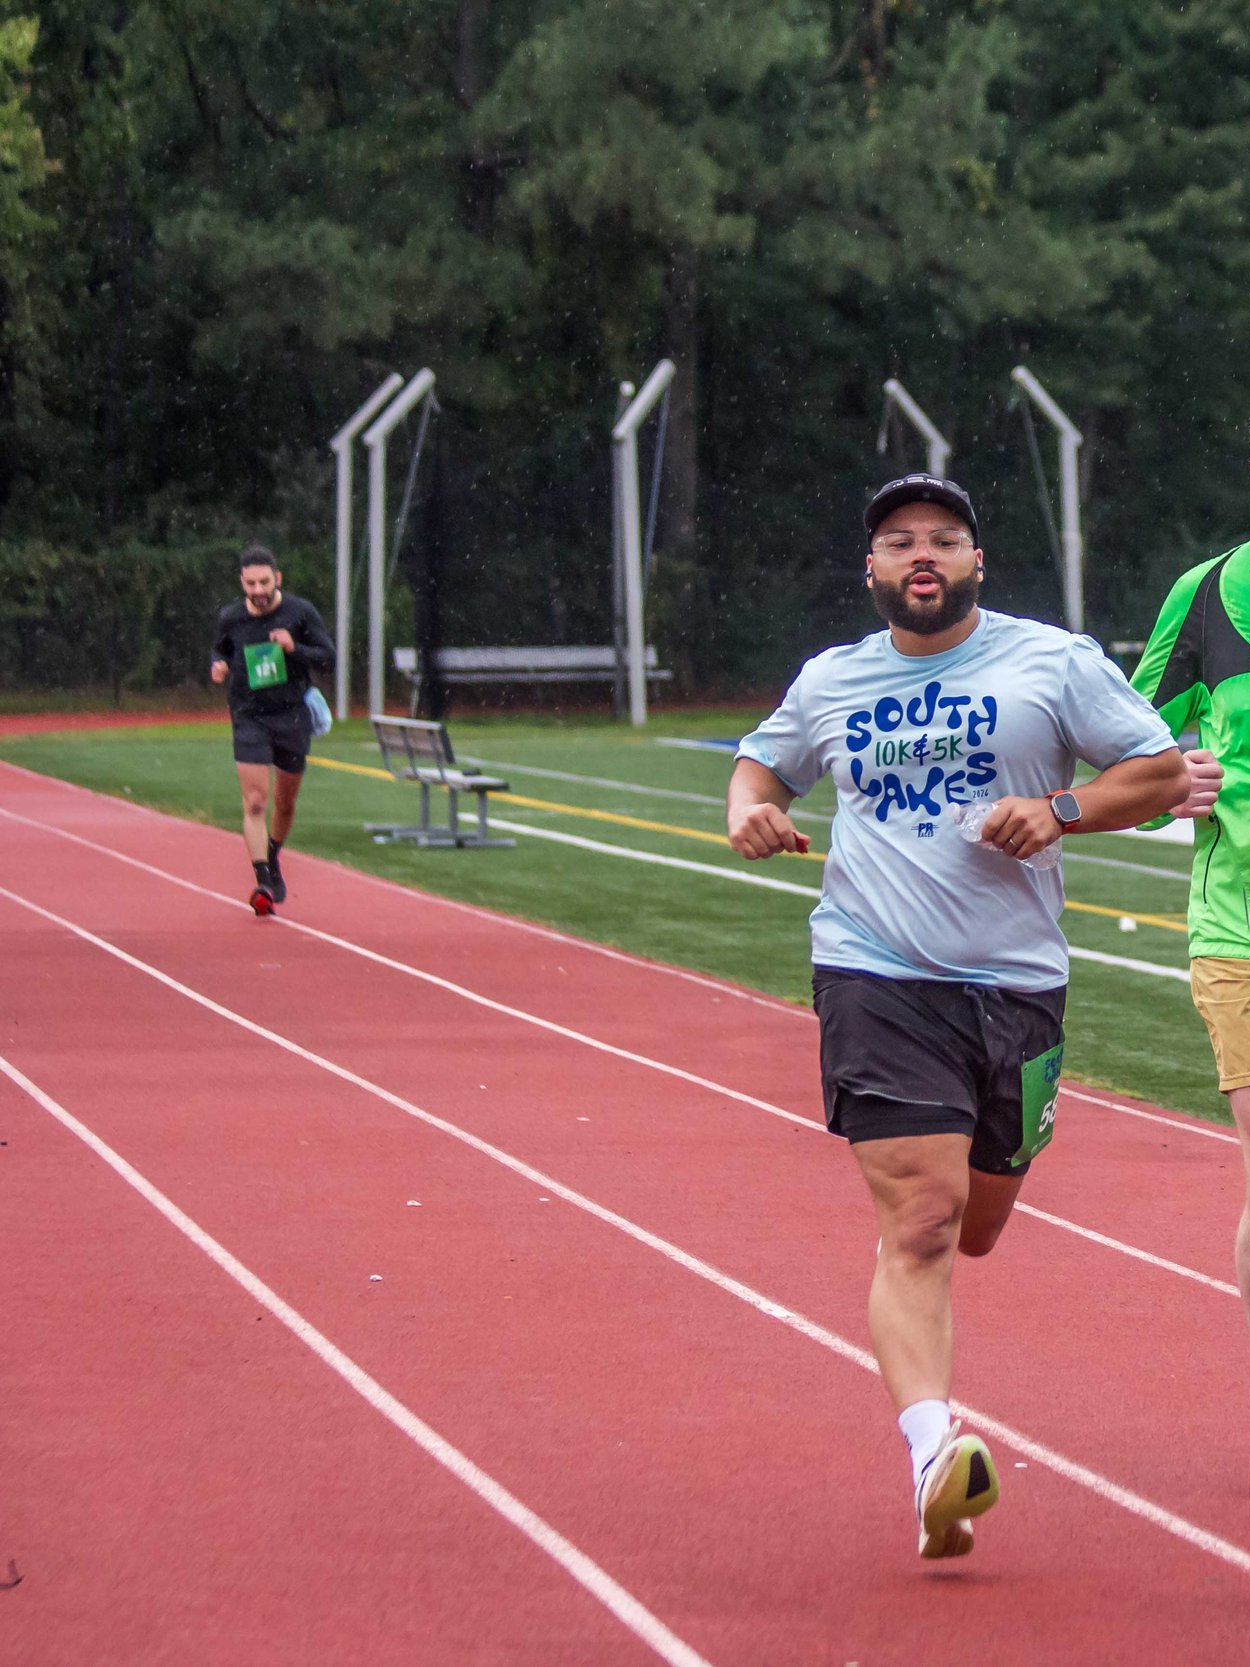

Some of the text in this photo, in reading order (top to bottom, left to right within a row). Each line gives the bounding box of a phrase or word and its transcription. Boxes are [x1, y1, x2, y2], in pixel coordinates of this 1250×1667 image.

[846, 681, 998, 752] SOUTH
[875, 739, 912, 767] 10K
[932, 736, 964, 761] 5K
[850, 751, 997, 822] LAKES
